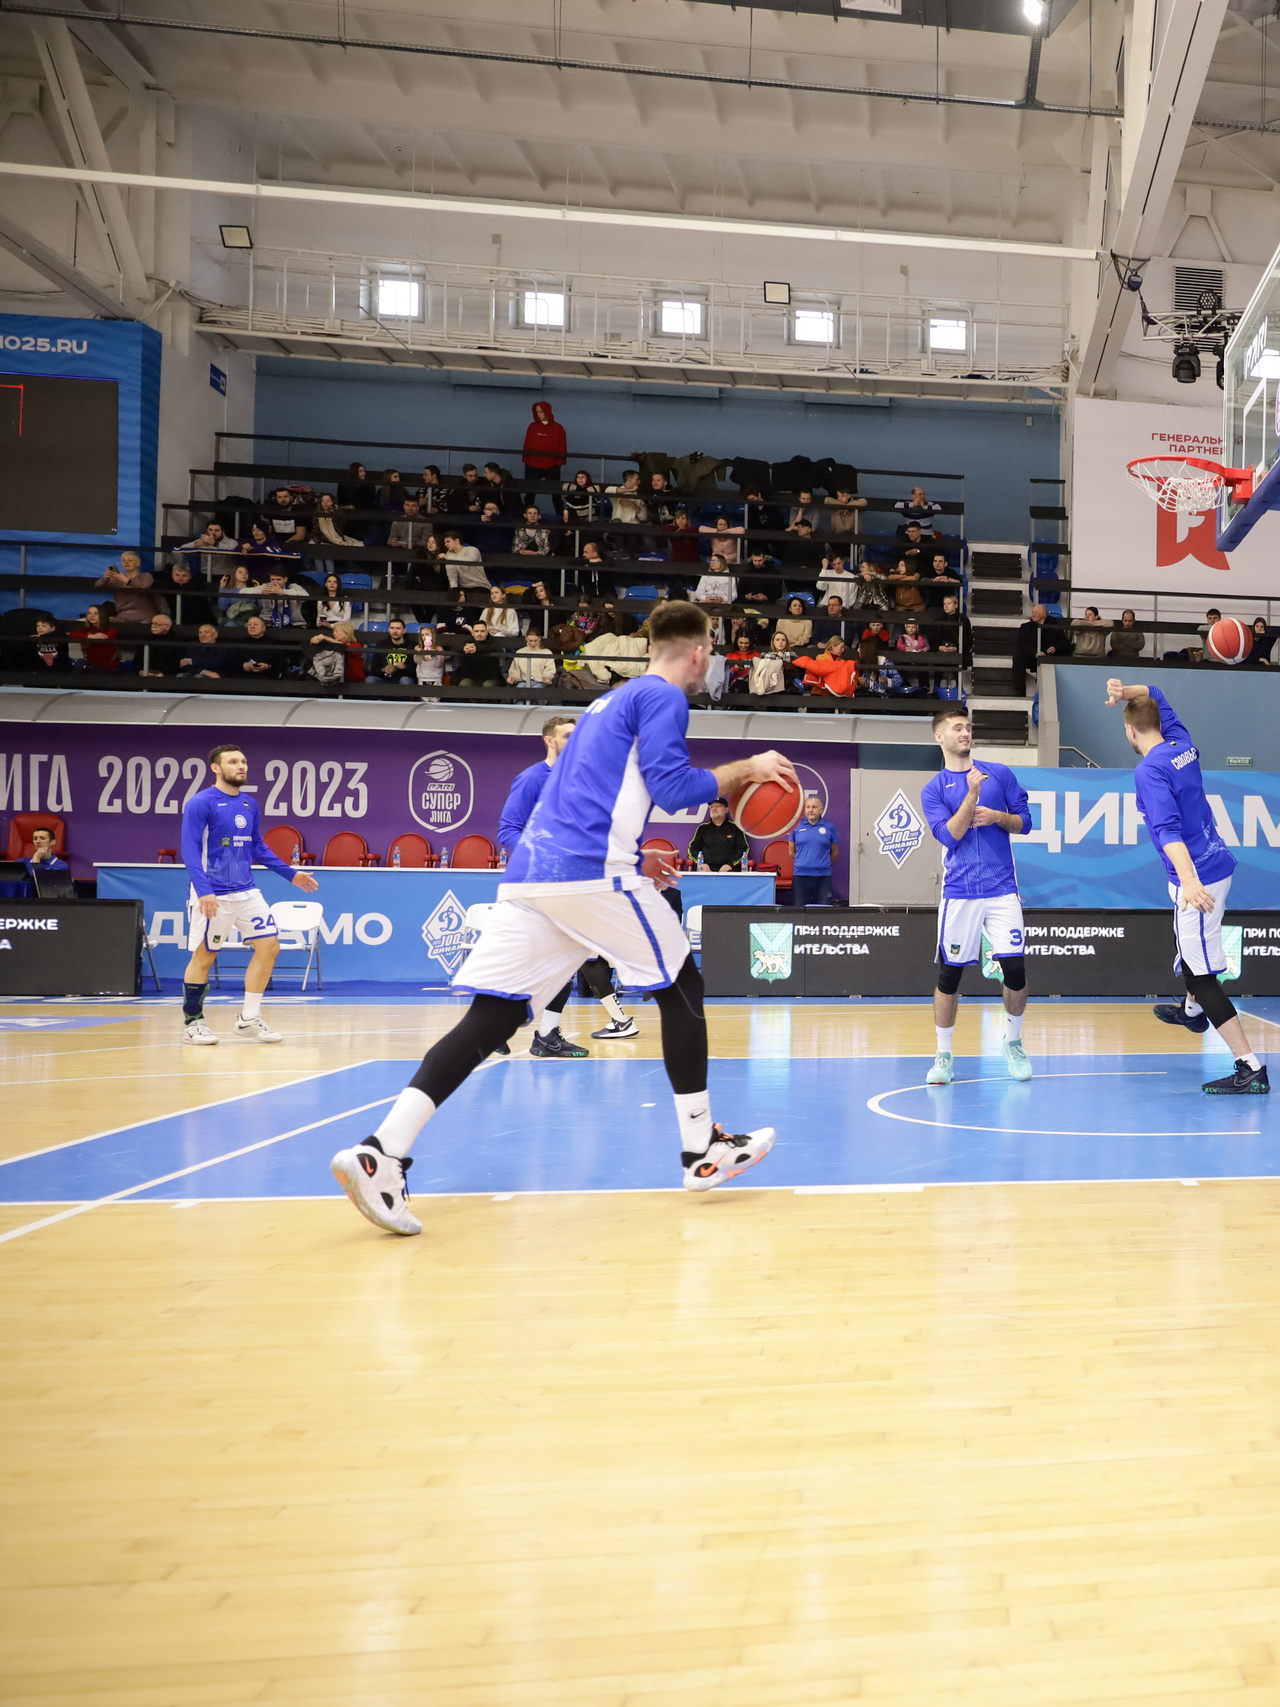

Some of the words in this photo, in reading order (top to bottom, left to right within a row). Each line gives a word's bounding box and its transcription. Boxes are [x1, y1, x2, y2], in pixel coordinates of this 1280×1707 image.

[0, 335, 88, 355] O25.RU
[421, 792, 461, 810] СУПЕР
[429, 811, 452, 823] ЛИГА
[883, 840, 918, 851] ДИНАМО
[251, 914, 276, 931] 24
[148, 911, 393, 950] ДМО
[795, 926, 820, 936] ПРИ
[822, 926, 900, 938] ПОДДЕРЖКЕ
[1009, 928, 1023, 946] 3
[1024, 927, 1047, 937] ПРИ
[1050, 926, 1125, 939] ПОДДЕРЖКЕ
[1244, 928, 1266, 938] ПРИ
